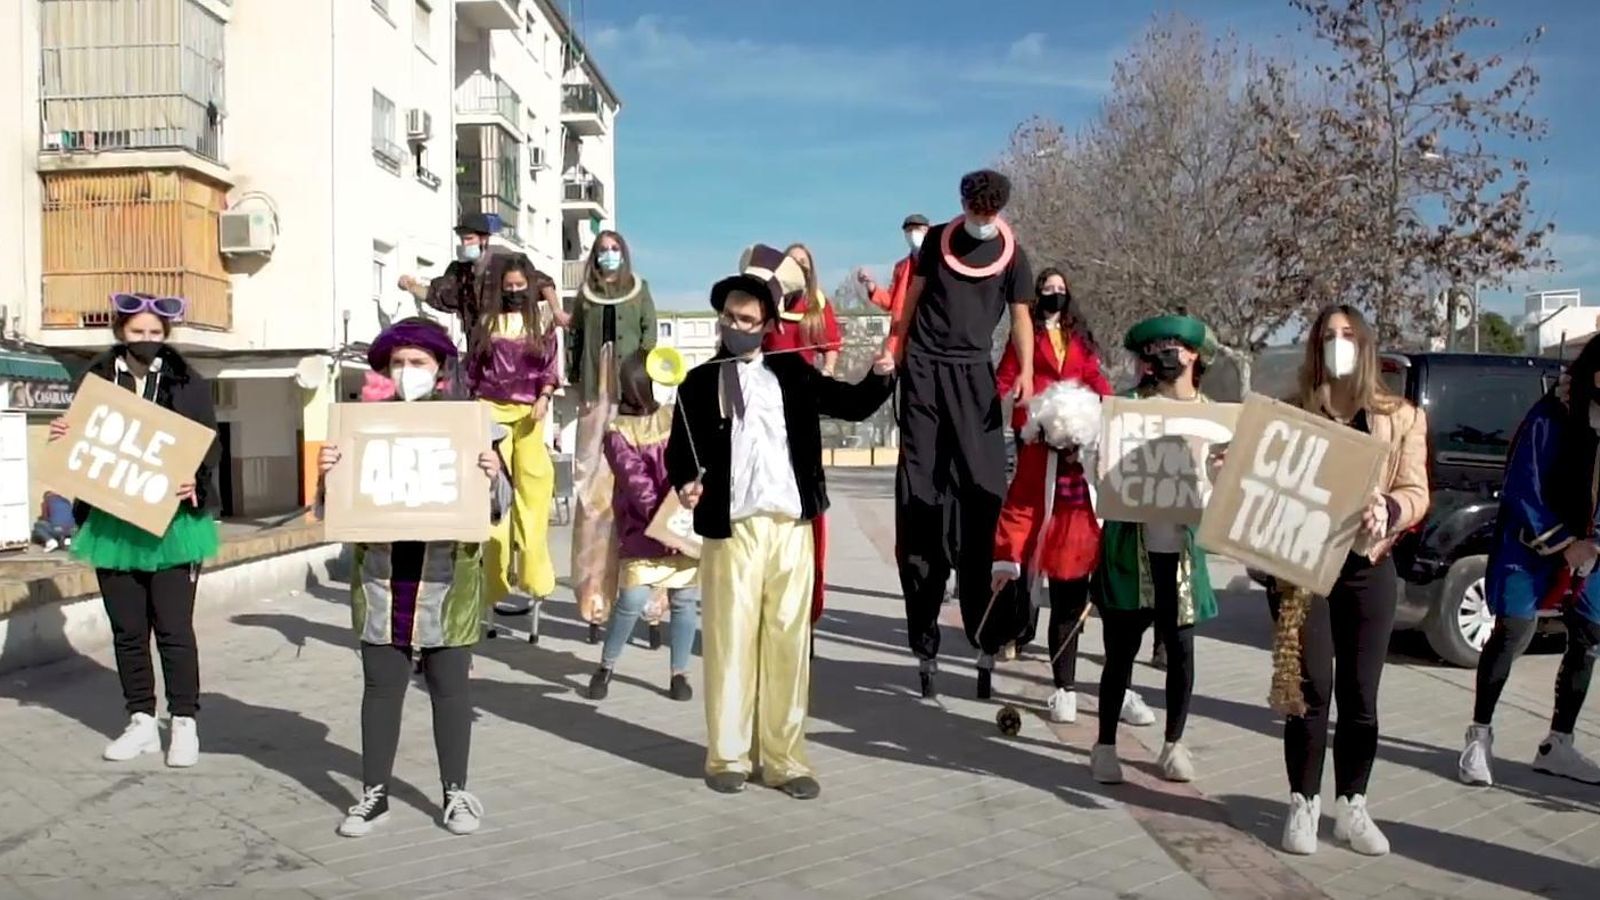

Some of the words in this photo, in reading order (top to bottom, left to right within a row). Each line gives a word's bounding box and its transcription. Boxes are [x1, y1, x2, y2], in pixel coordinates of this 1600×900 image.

[85, 404, 176, 467] COLE
[1253, 420, 1332, 505] CUL
[68, 440, 169, 504] CTIVO
[360, 437, 458, 508] ARTE
[1228, 478, 1331, 570] TURA
